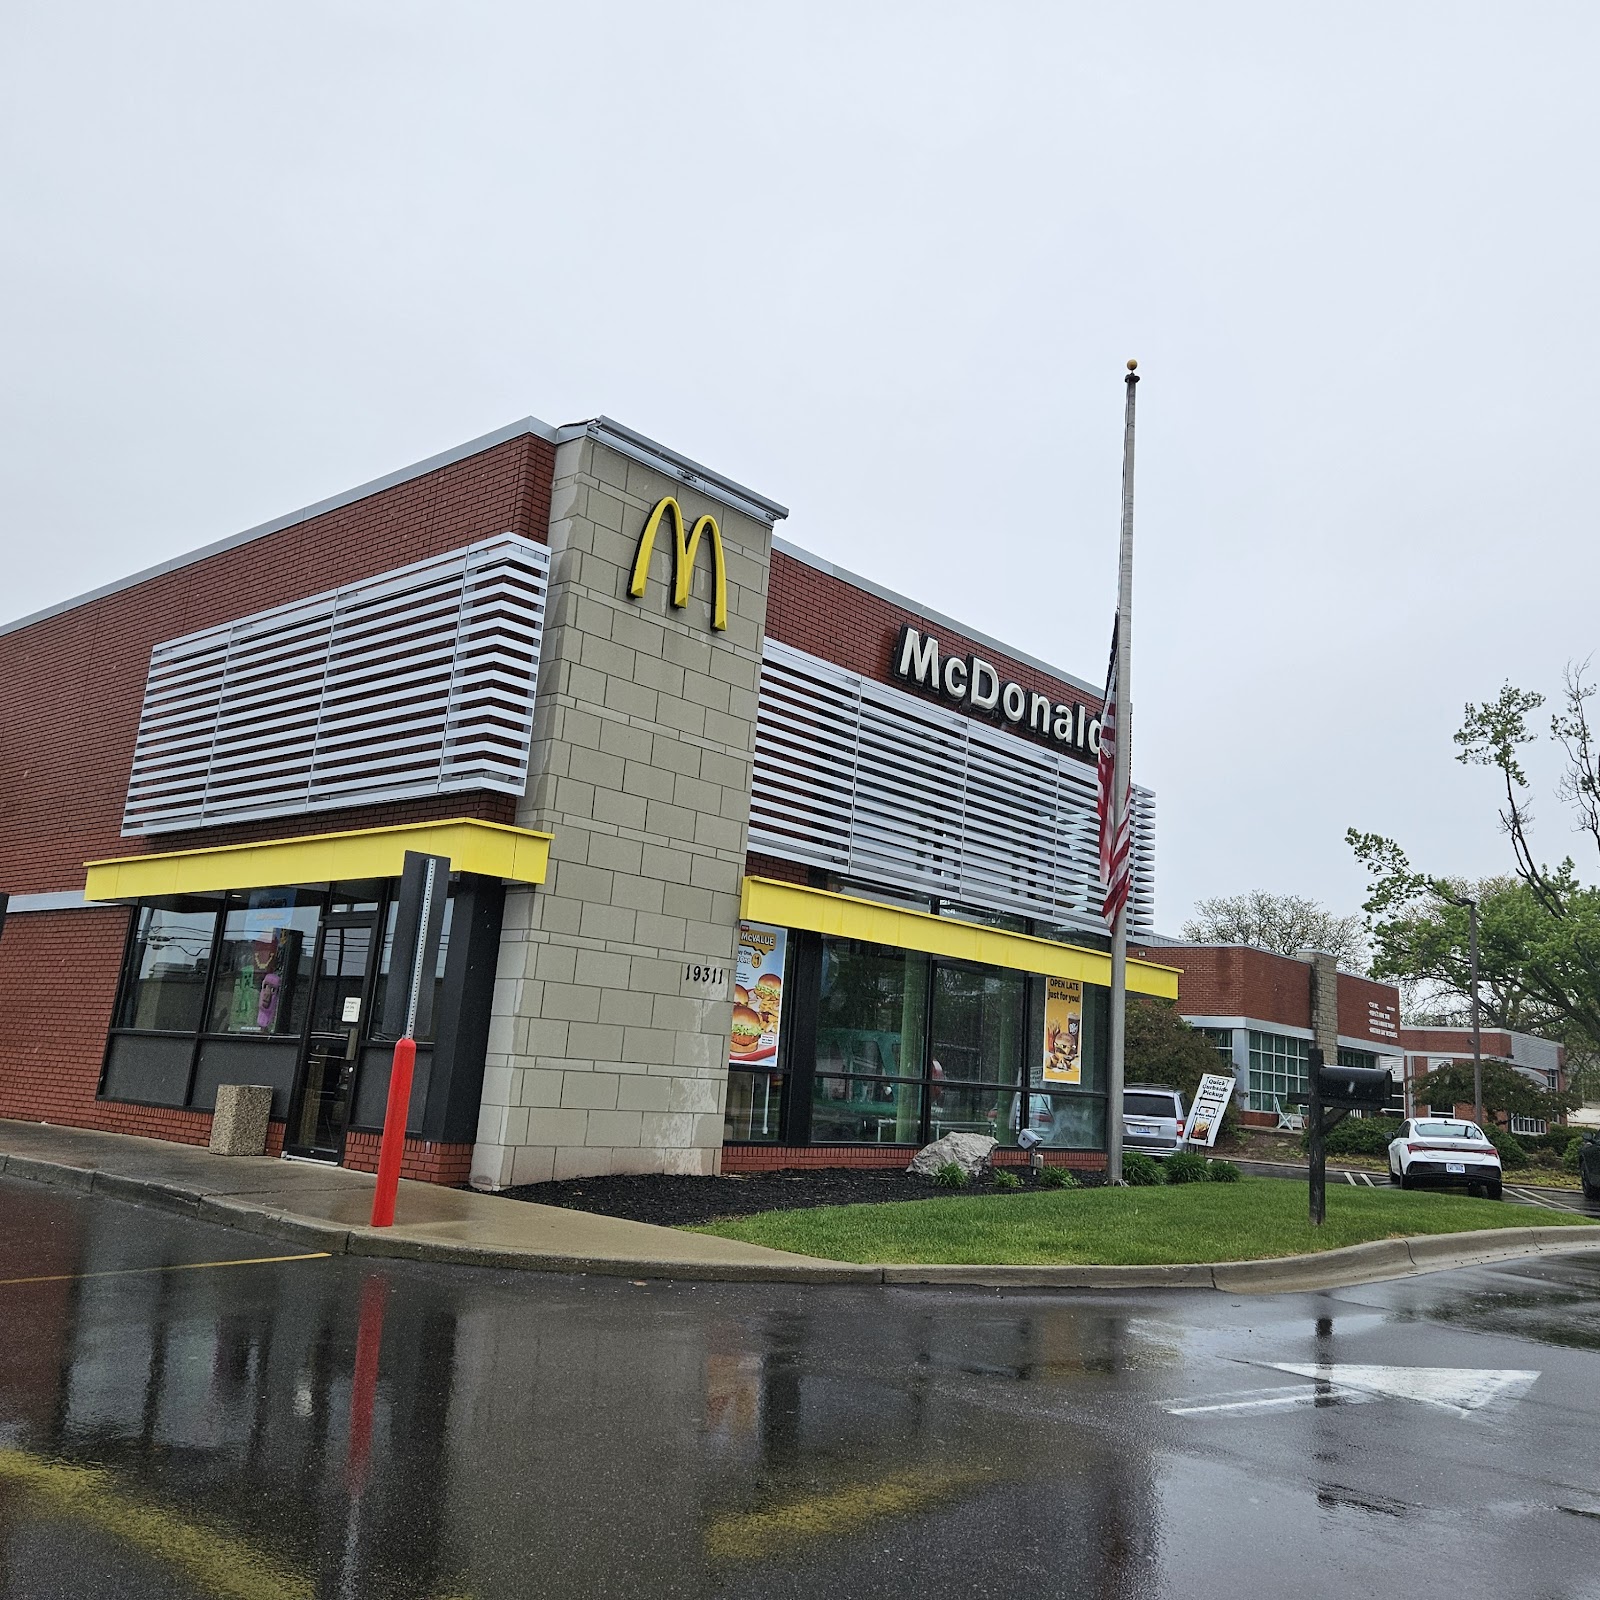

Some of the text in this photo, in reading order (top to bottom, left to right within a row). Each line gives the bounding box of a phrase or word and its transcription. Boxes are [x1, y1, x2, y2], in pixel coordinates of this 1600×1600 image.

[741, 932, 774, 946] McVALUE
[686, 964, 723, 984] 19311
[1050, 979, 1079, 990] OPEN LATE
[1048, 989, 1059, 1000] just
[1060, 991, 1068, 1001] for
[1202, 1084, 1229, 1092] Curbside
[1202, 1090, 1224, 1098] Pickup
